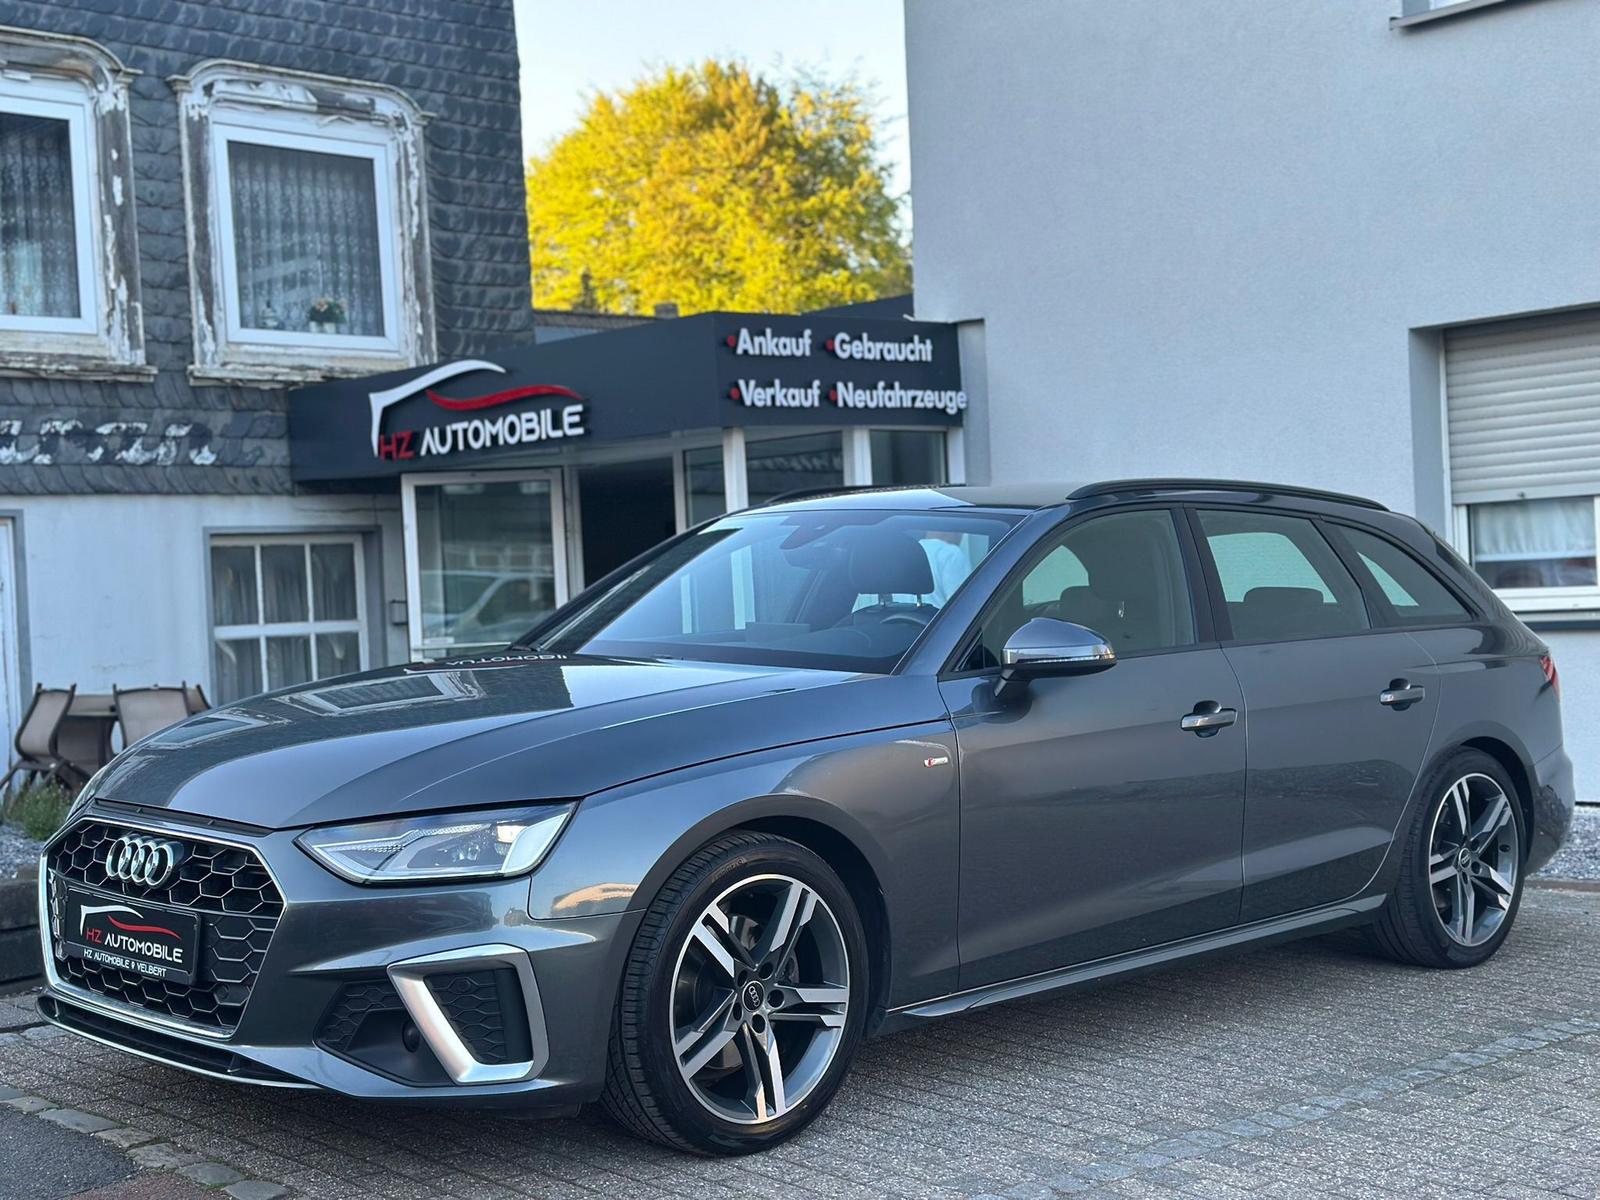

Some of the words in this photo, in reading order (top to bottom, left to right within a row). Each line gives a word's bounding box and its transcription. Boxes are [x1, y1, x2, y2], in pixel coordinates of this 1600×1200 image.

[736, 328, 812, 356] Ankauf
[833, 332, 933, 362] Gebraucht
[738, 379, 821, 408] Verkauf
[836, 381, 967, 415] Neufahrzeuge
[379, 431, 415, 462] HZ
[420, 404, 584, 456] AUTOMOBILE
[84, 949, 93, 958] HZ
[94, 952, 130, 968] AUTOMOBILE
[137, 962, 167, 977] VELBERT
[86, 927, 102, 944] HZ
[105, 932, 183, 963] AUTOMOBILE
